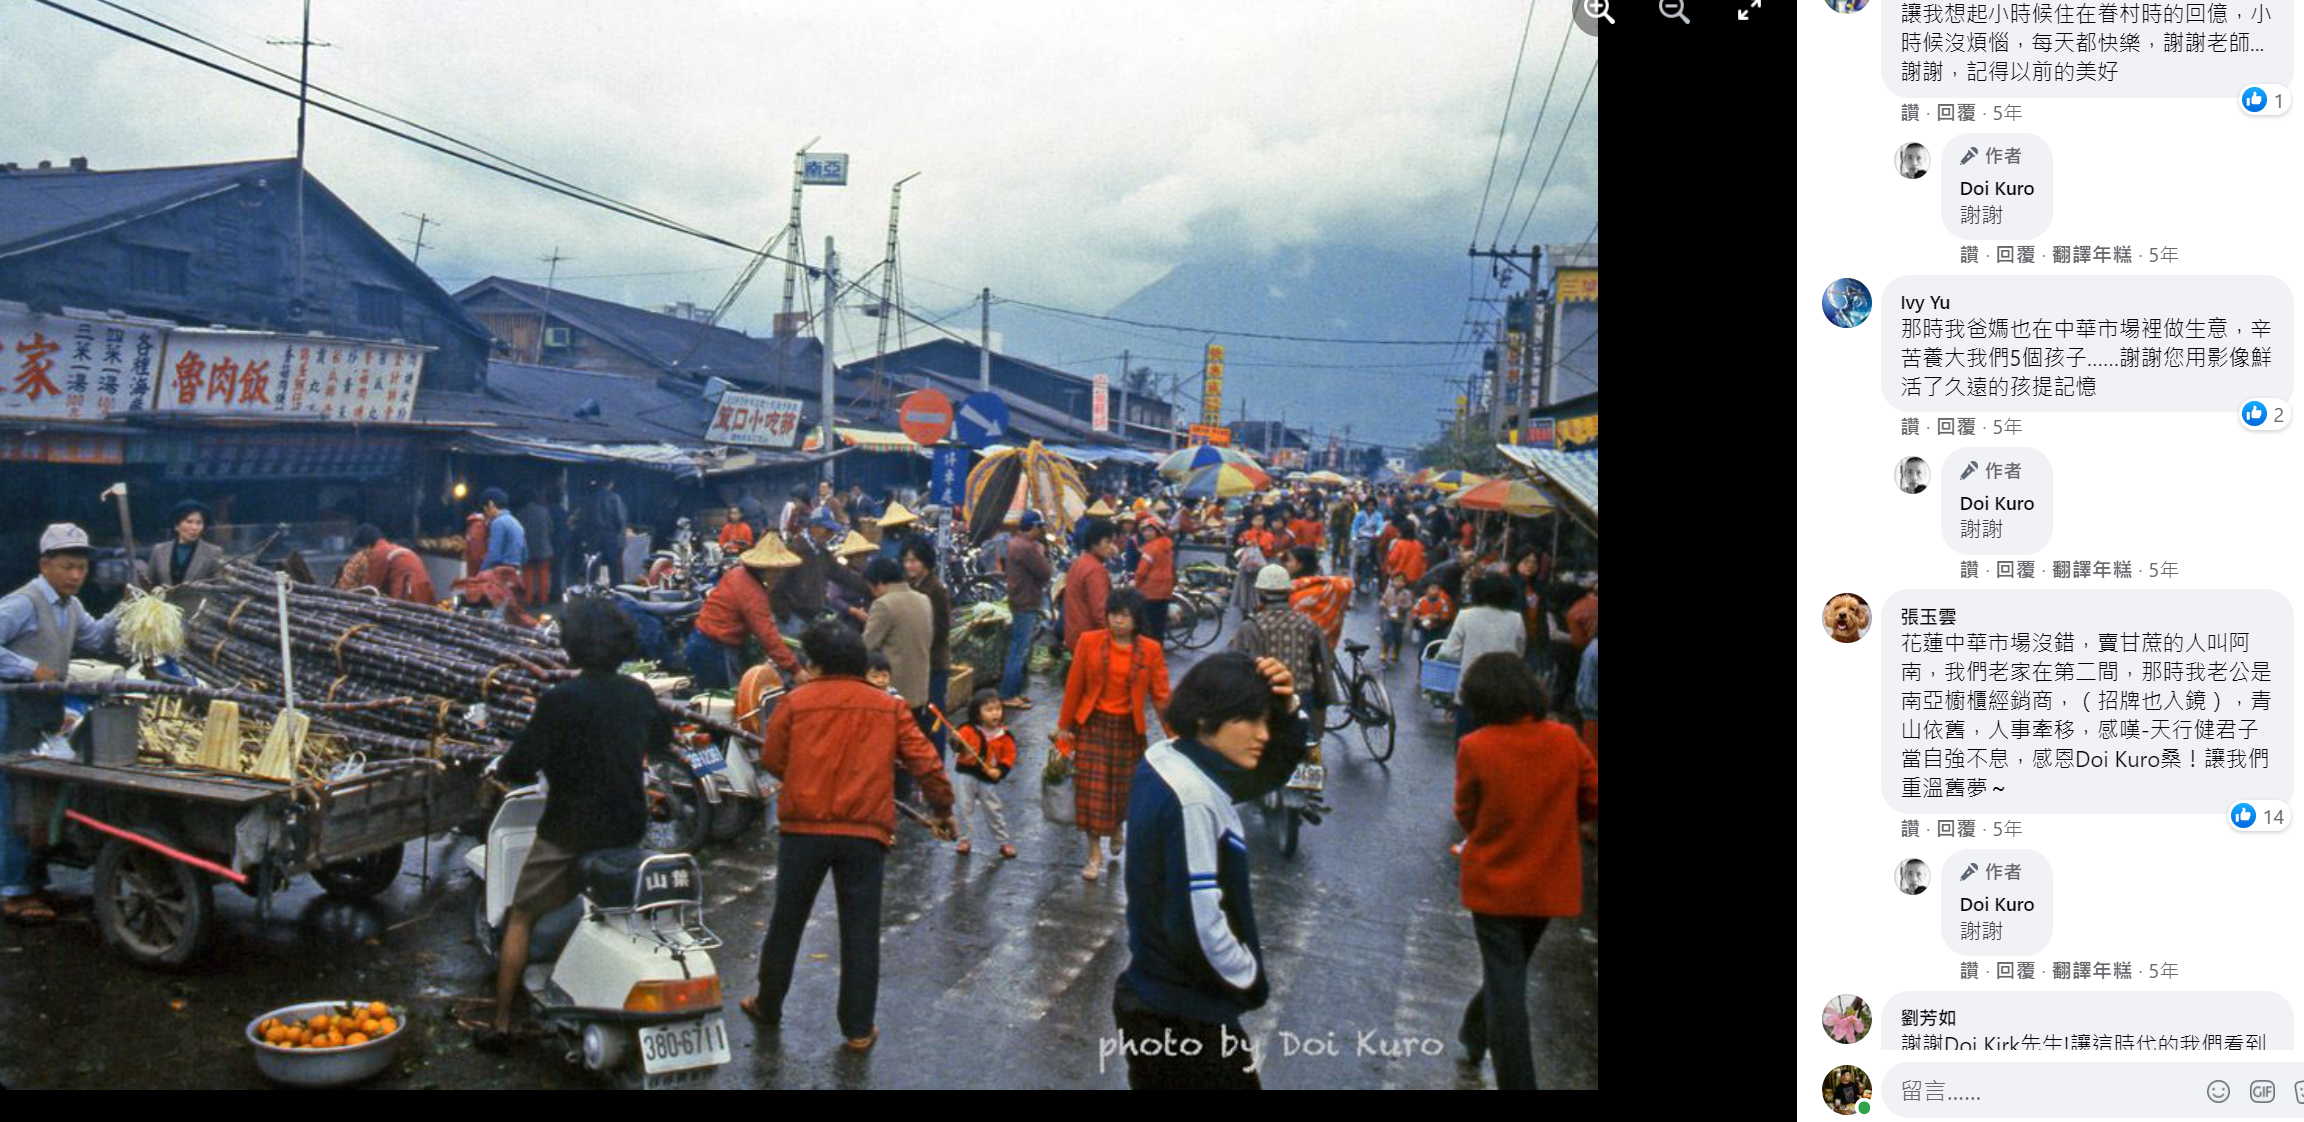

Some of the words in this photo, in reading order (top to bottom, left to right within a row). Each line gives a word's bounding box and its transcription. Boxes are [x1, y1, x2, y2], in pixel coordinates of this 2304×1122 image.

[1901, 61, 2118, 81] 謝謝，記得以前的美好
[2275, 94, 2282, 108] 1
[1901, 103, 1919, 121] 讚
[1938, 104, 1975, 121] 回覆
[1994, 104, 2022, 121] 5年
[1986, 147, 2022, 164] 作者
[805, 160, 842, 178] 南亞
[1961, 180, 1989, 195] Doi
[1996, 181, 2034, 195] Kuro
[1960, 205, 2003, 224] 謝謝
[1961, 245, 1978, 263] 讚
[1997, 246, 2035, 263] 回覆
[2053, 245, 2132, 263] 翻譯年糕
[2150, 246, 2178, 263] 5年
[1901, 296, 1925, 313] Ivy
[1930, 296, 1950, 310] Yu
[1902, 318, 2271, 339] 那時我爸媽也在中華市場裡做生意，辛
[0, 332, 62, 401] 家
[67, 323, 95, 393] 三菜一湯
[98, 327, 125, 395] 四菜一湯
[172, 349, 272, 405] 魯肉飯
[1902, 376, 2096, 396] 活了久遠的孩提記憶
[2273, 407, 2283, 423] 2
[1901, 417, 1919, 435] 讚
[1938, 418, 1975, 435] 回覆
[1994, 418, 2022, 435] 5年
[1986, 461, 2022, 478] 作者
[1961, 495, 1989, 510] Doi
[1996, 496, 2034, 510] Kuro
[1960, 519, 2003, 538] 謝謝
[1961, 560, 1978, 578] 讚
[1997, 561, 2035, 578] 回覆
[2053, 560, 2132, 578] 翻譯年糕
[2150, 561, 2178, 578] 5年
[1901, 608, 1956, 625] 張玉雲
[1901, 632, 2249, 652] 花蓮中華市場沒錯，賣甘蔗的人叫阿
[1901, 661, 2271, 682] 南，我們老家在第二間，那時我老公是
[2264, 810, 2284, 825] 14
[1901, 819, 1919, 837] 讚
[1938, 820, 1975, 837] 回覆
[1994, 820, 2022, 837] 5年
[645, 869, 690, 891] 山葉
[1986, 863, 2022, 880] 作者
[1961, 896, 1989, 911] Doi
[1996, 897, 2034, 911] Kuro
[1960, 921, 2003, 940] 謝謝
[1961, 961, 1978, 979] 讚
[1997, 962, 2035, 979] 回覆
[2053, 961, 2132, 979] 翻譯年糕
[2150, 962, 2178, 979] 5年
[1901, 1009, 1955, 1026] 劉芳如
[643, 1025, 724, 1061] 380-6711
[2252, 1085, 2273, 1098] GIF
